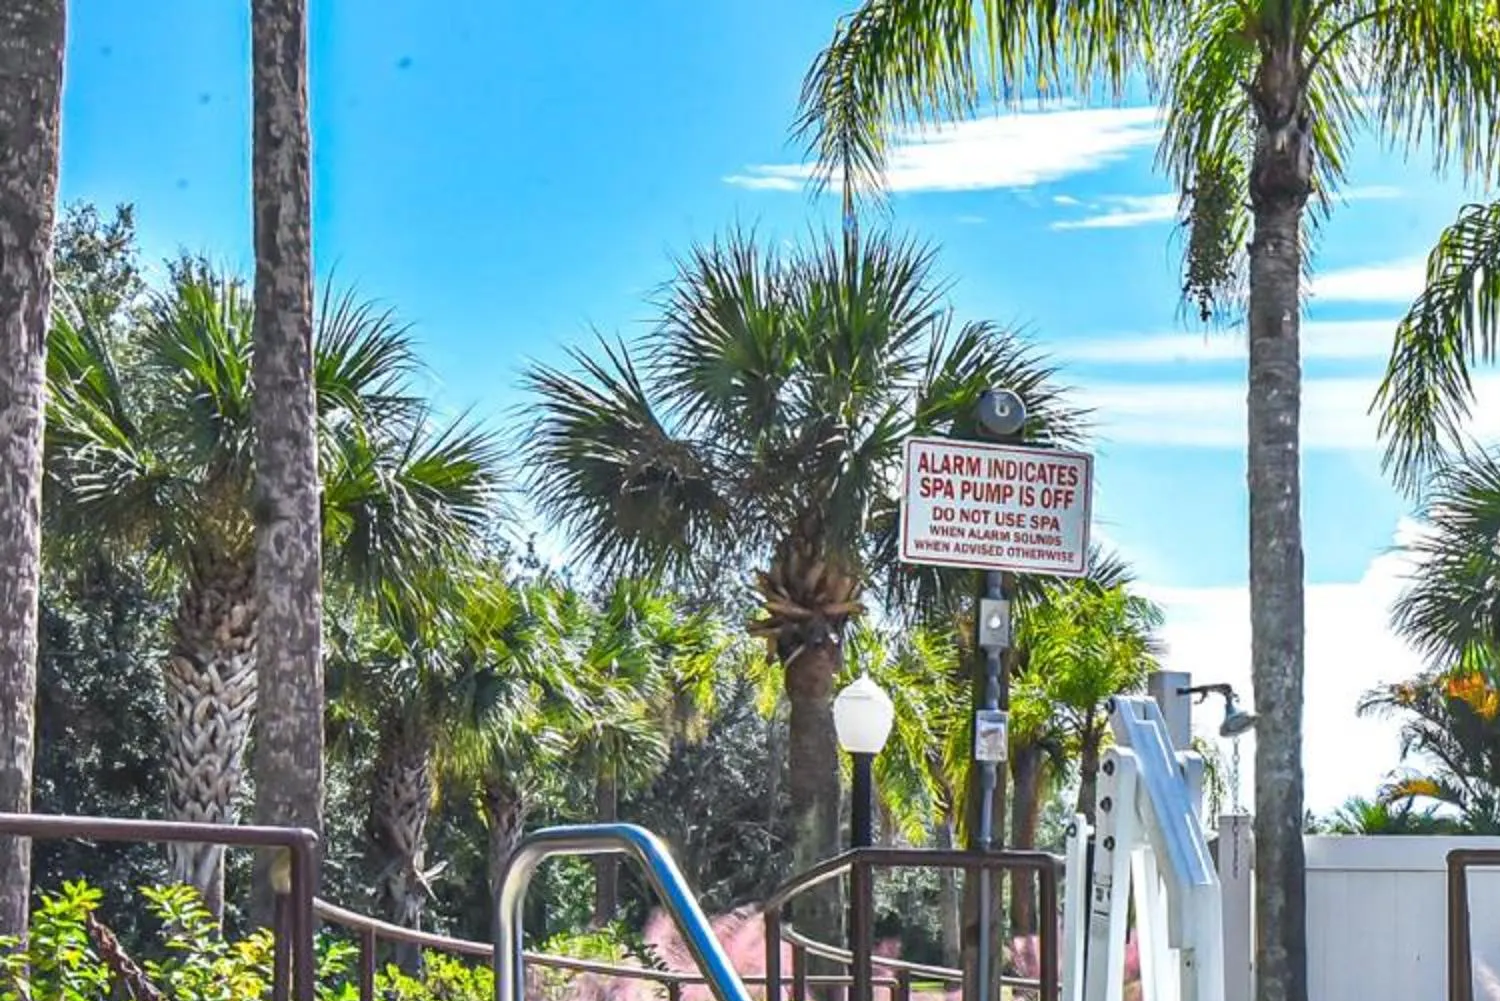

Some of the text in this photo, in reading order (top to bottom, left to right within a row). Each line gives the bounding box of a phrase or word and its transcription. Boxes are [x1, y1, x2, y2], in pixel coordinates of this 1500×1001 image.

[918, 452, 1078, 486] ALARM INDICATES
[920, 477, 1074, 509] SPA PUMP IS OFF
[932, 506, 1060, 531] DO NOT USE SPA
[929, 525, 1062, 546] WHEN ALARM SOUNDS
[953, 543, 1004, 557] ADVISED
[1007, 546, 1074, 562] OTHERWISE
